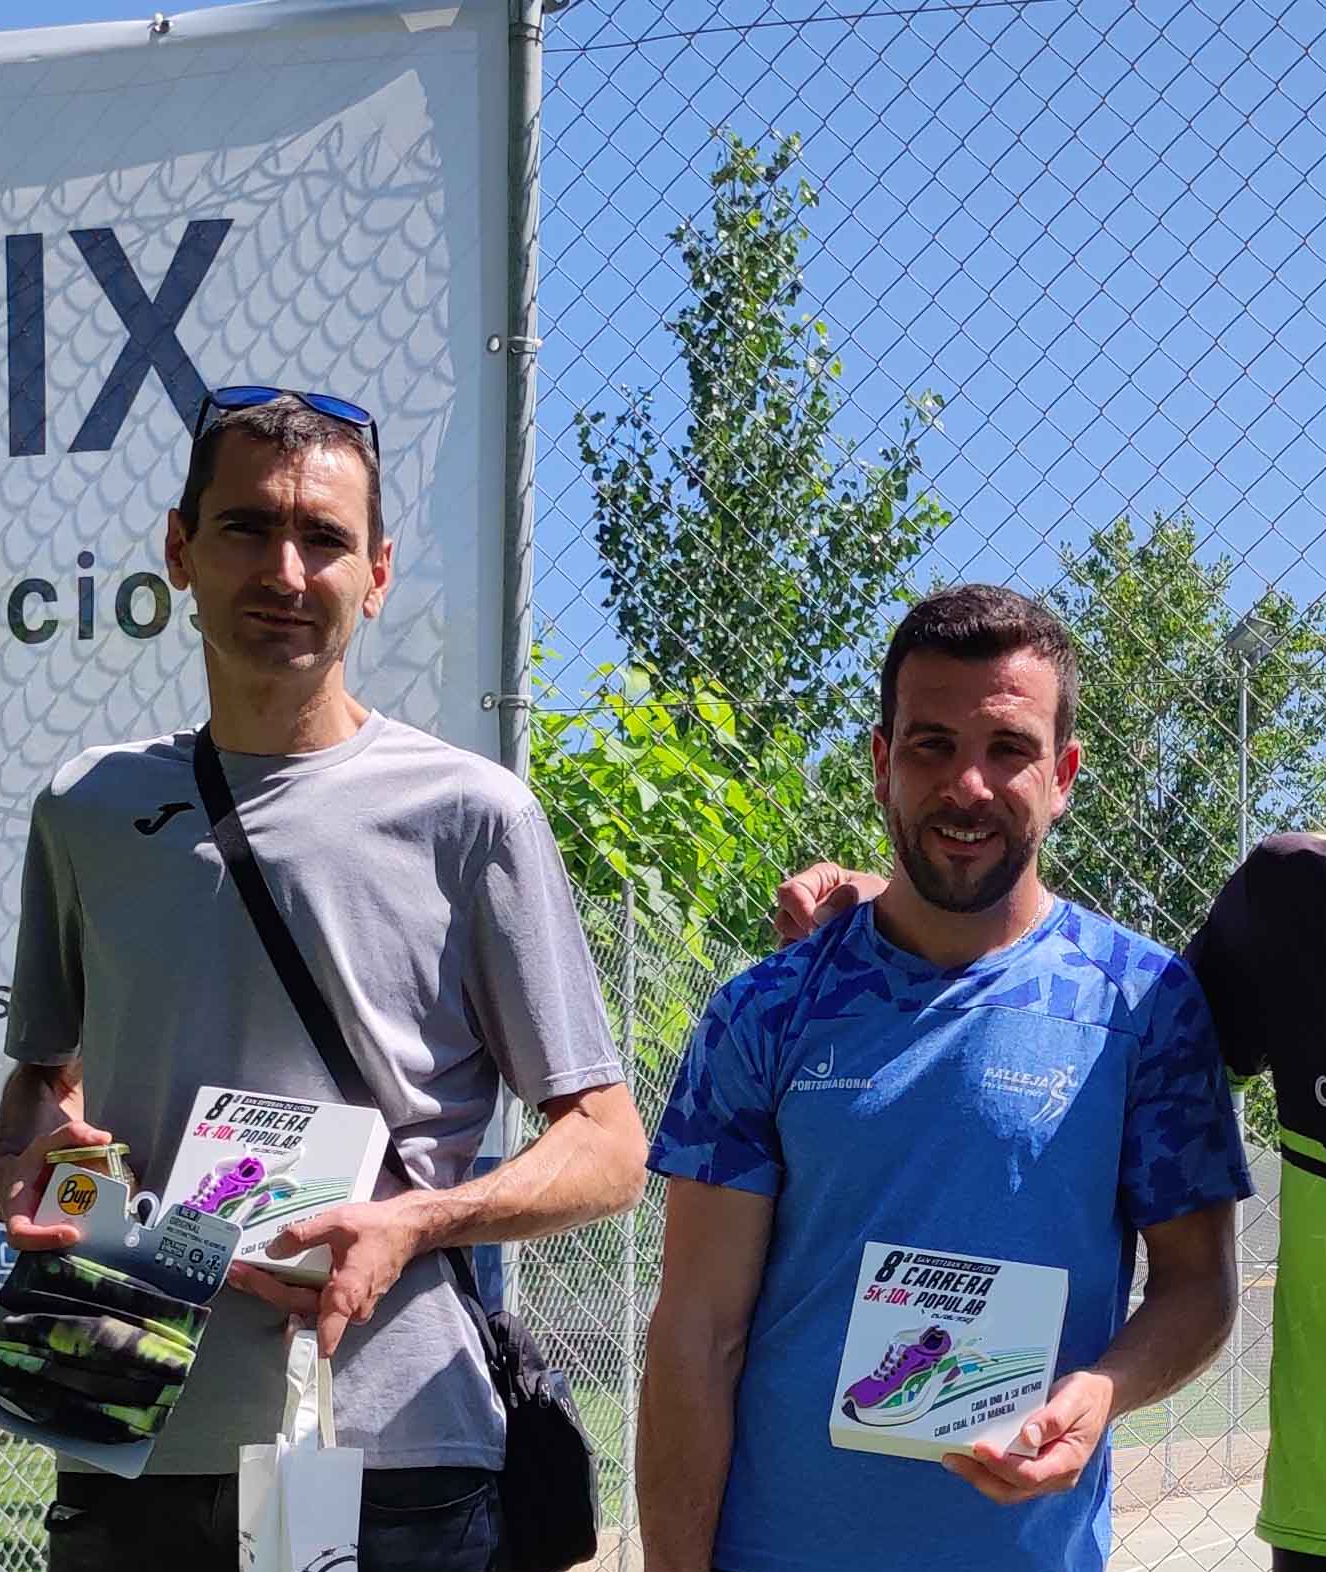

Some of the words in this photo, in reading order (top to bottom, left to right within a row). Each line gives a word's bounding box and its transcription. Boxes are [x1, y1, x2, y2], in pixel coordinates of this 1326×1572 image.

[228, 1106, 313, 1133] CARRERA
[236, 1128, 303, 1150] POPULAR
[60, 1180, 96, 1210] Buff
[901, 1266, 995, 1297] CARRERA
[913, 1291, 987, 1316] POPULAR
